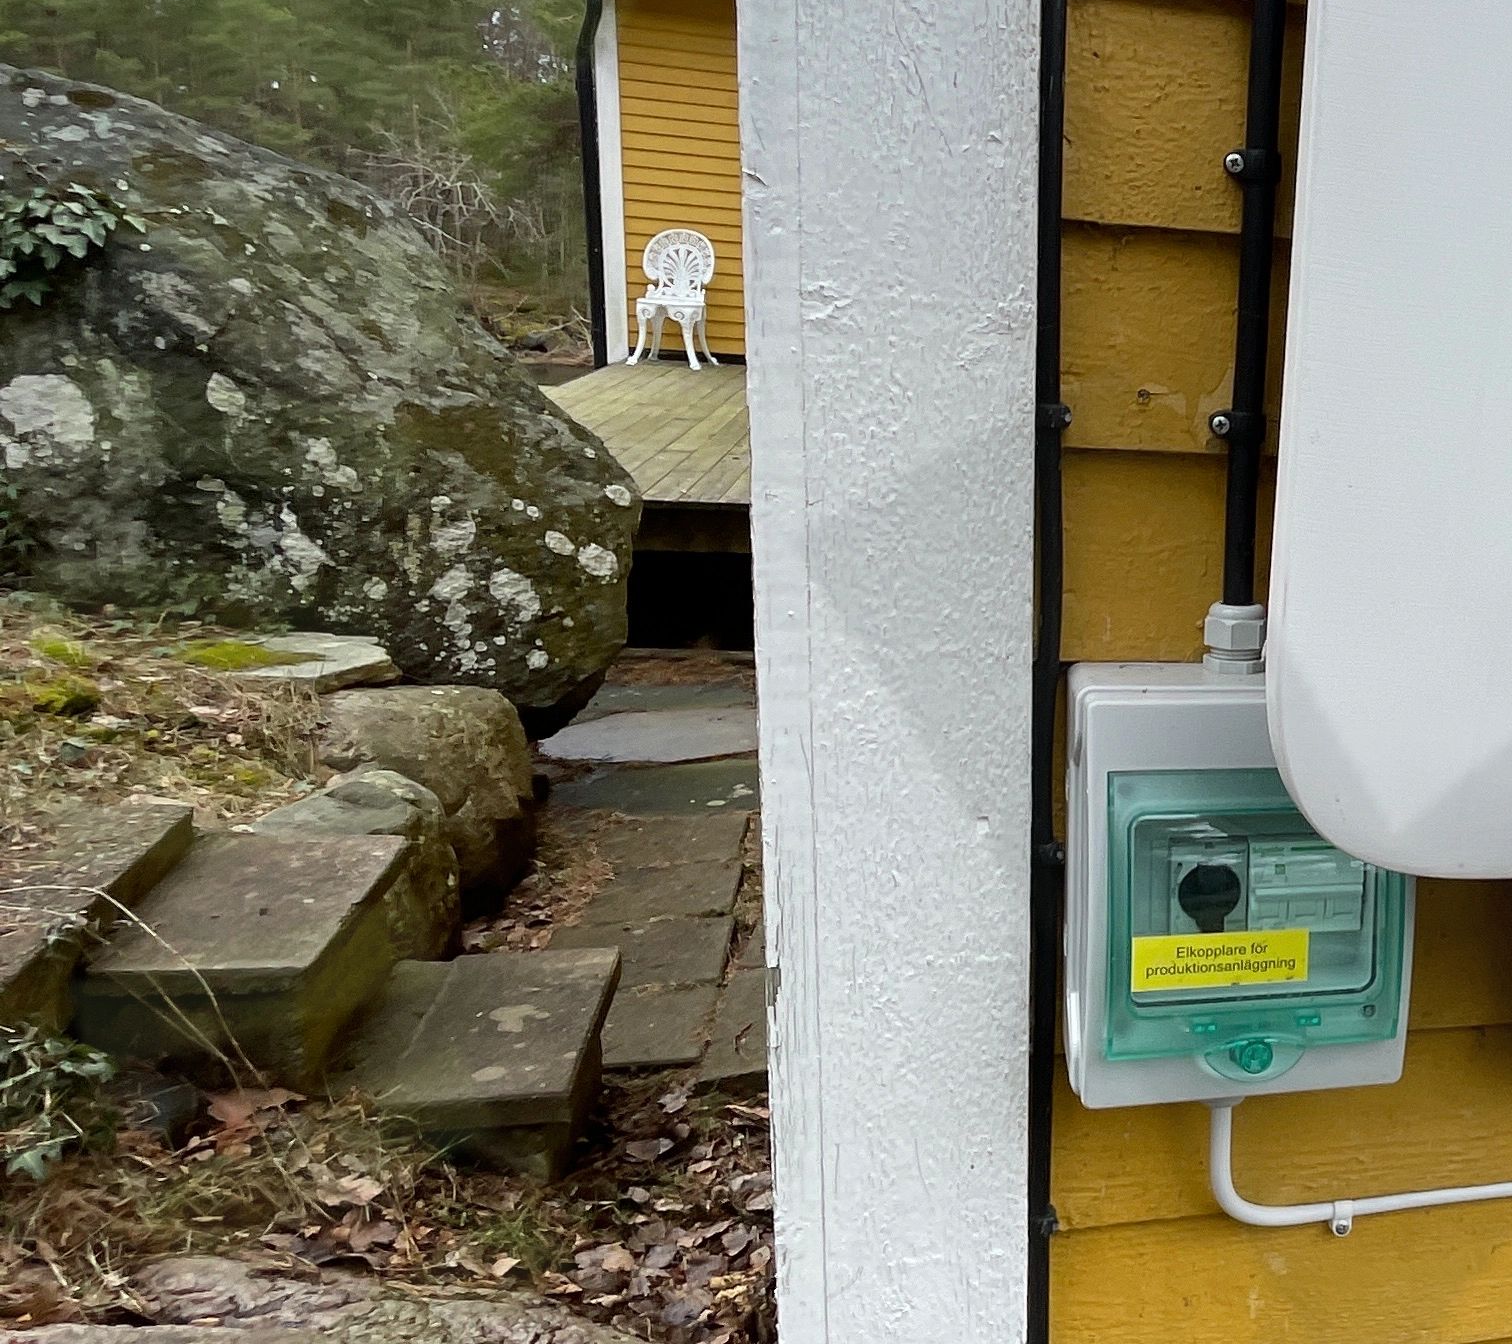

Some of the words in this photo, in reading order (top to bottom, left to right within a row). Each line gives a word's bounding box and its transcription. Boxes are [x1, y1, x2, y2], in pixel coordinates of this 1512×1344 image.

[1176, 945, 1247, 960] Elkopplare
[1250, 942, 1268, 955] för
[1145, 957, 1296, 979] produktionsanläggning
